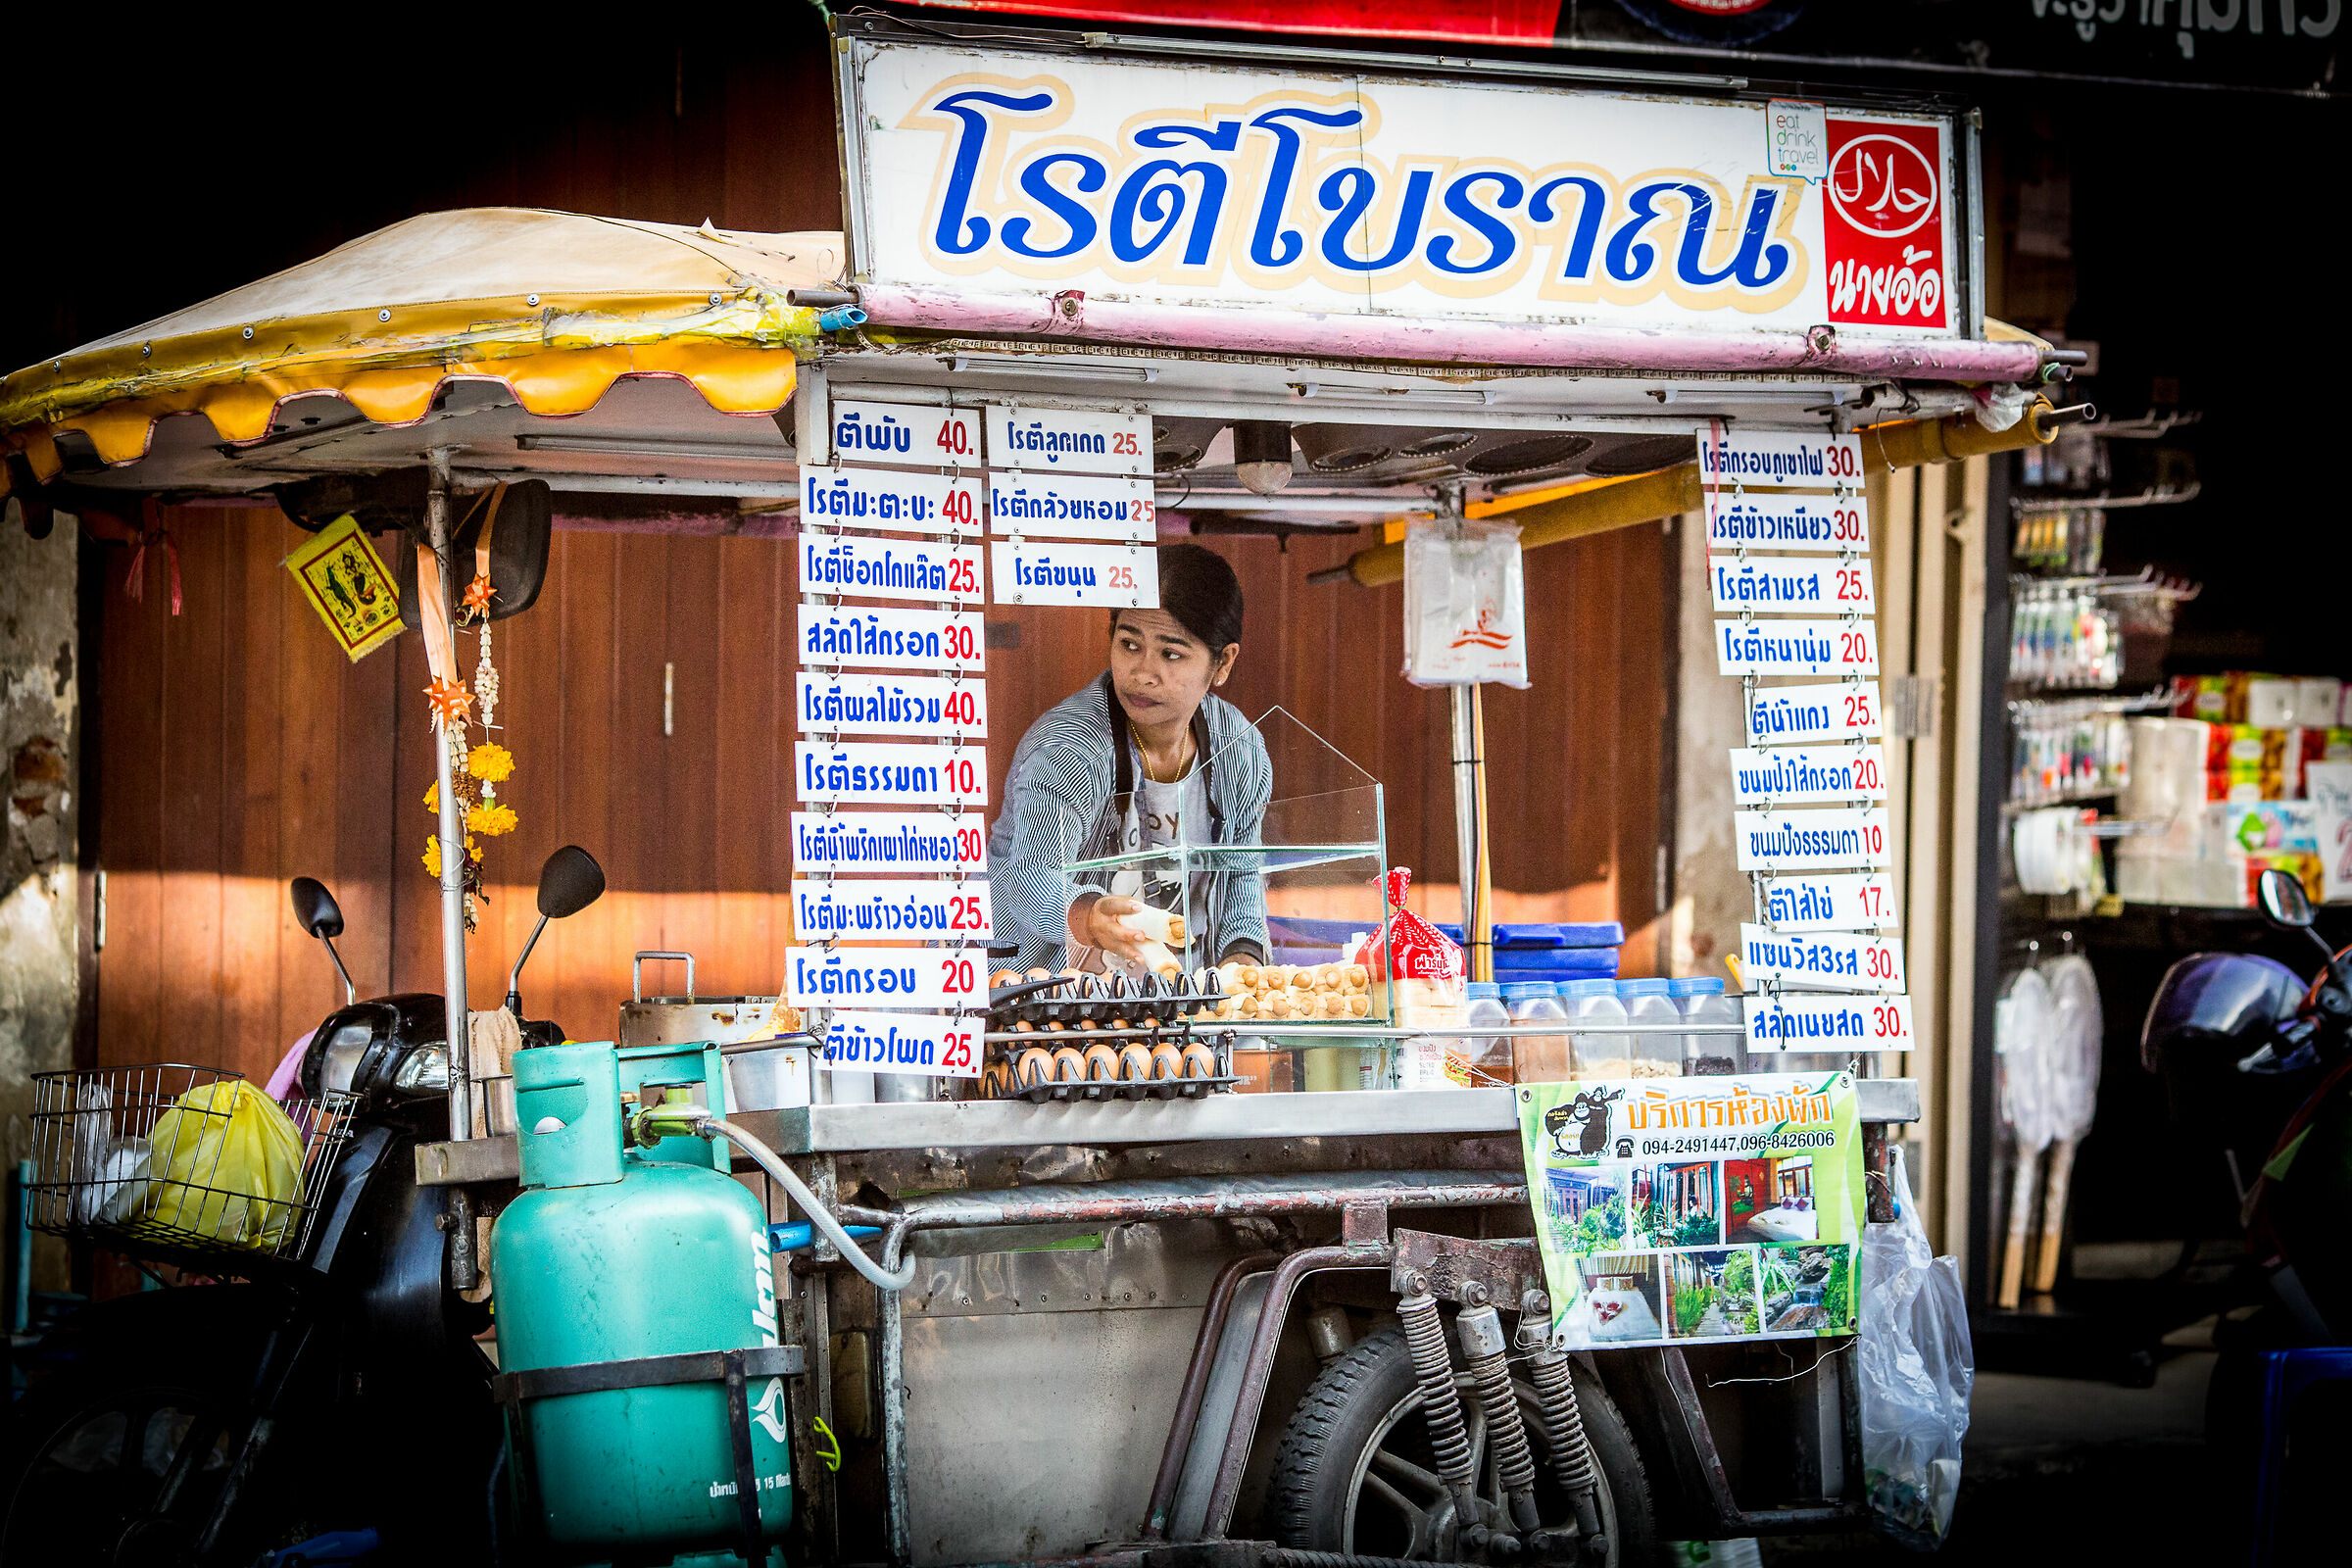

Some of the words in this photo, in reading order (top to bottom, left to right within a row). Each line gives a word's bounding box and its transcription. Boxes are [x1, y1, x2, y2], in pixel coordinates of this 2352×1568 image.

[1777, 114, 1799, 128] eat
[1777, 128, 1816, 147] drink
[1778, 146, 1819, 165] travel
[934, 92, 1788, 287] โรตีโบราณ
[1830, 245, 1941, 318] นายอ้อ
[937, 420, 973, 455] 40.
[1008, 421, 1104, 463] โรตีลูกเกด
[1113, 432, 1142, 455] 25.
[1703, 442, 1823, 482] โรตีกรอบภูเขาไฟ
[1827, 446, 1860, 476] 30.
[943, 490, 978, 524] 40.
[993, 489, 1127, 520] โรตีกล้วยหอม
[1131, 500, 1154, 521] 25
[1713, 506, 1831, 540] โรตีข้าวเหนียว
[1835, 510, 1864, 541] 30.
[949, 559, 979, 593] 25.
[1015, 558, 1096, 597] โรตีขนุน
[1718, 566, 1819, 600] โรตีสามรส
[1837, 570, 1868, 600] 25.
[945, 625, 980, 659] 30.
[1841, 633, 1872, 662] 20.
[806, 684, 940, 722] โรตีผลไม้รวม
[944, 692, 981, 725] 40.
[1844, 696, 1875, 726] 25.
[806, 754, 937, 792] โรตีธรรมดา
[945, 760, 981, 794] 10.
[1853, 760, 1884, 789] 20.
[957, 829, 981, 861] 30
[1751, 823, 1858, 857] ขนมปังธรรมดา
[1864, 825, 1882, 854] 10
[801, 894, 947, 929] โรตีมะพร้าวอ่อน
[950, 897, 989, 929] 25.
[1860, 887, 1889, 916] 17.
[798, 956, 915, 994] โรตีกรอบ
[942, 960, 974, 993] 20
[1867, 948, 1897, 980] 30.
[1754, 1005, 1863, 1038] สลัดเนยสด
[1874, 1006, 1906, 1037] 30.
[942, 1033, 976, 1073] 25.
[1642, 1132, 1836, 1155] 094-2491447,096-8426006
